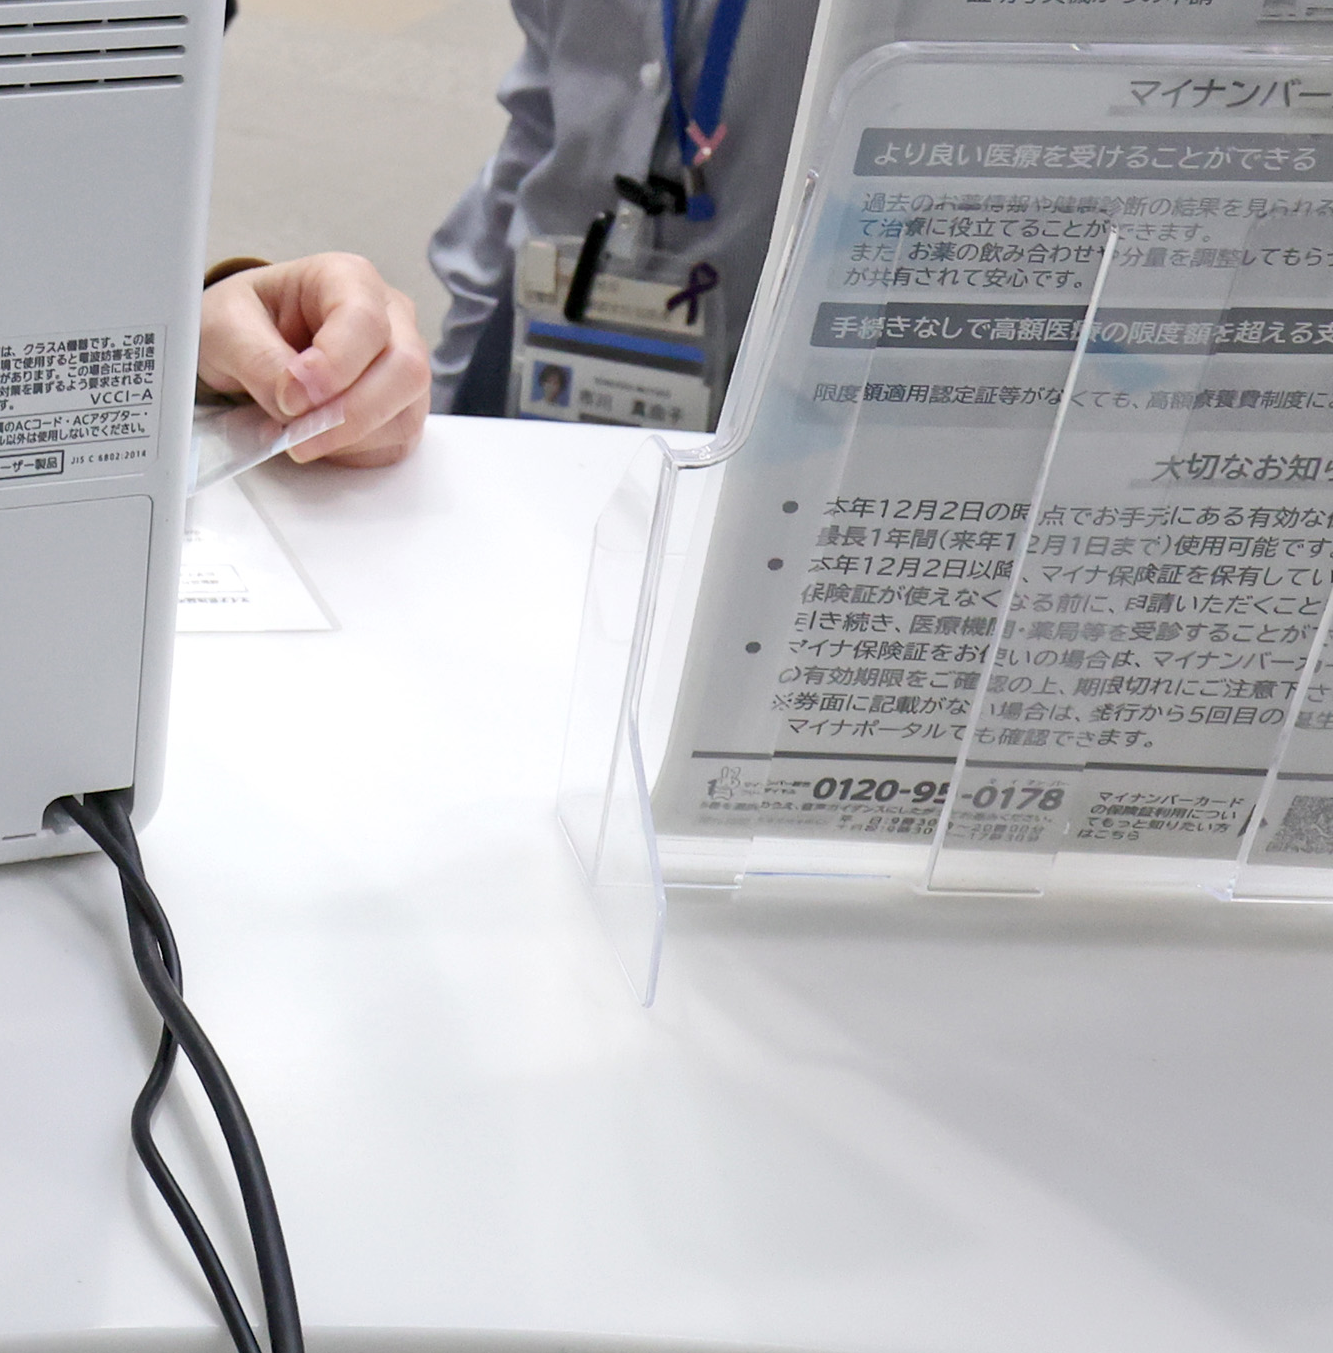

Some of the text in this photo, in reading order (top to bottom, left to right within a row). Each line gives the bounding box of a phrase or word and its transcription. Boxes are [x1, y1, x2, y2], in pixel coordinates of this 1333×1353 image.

[873, 142, 1317, 172] より良い医療を受けることができる
[815, 383, 1333, 410] 限度額適用認定証等がなくても、高額療養費制度に
[801, 583, 1329, 615] 保険証が使えなくなる前に、申請いただくこと
